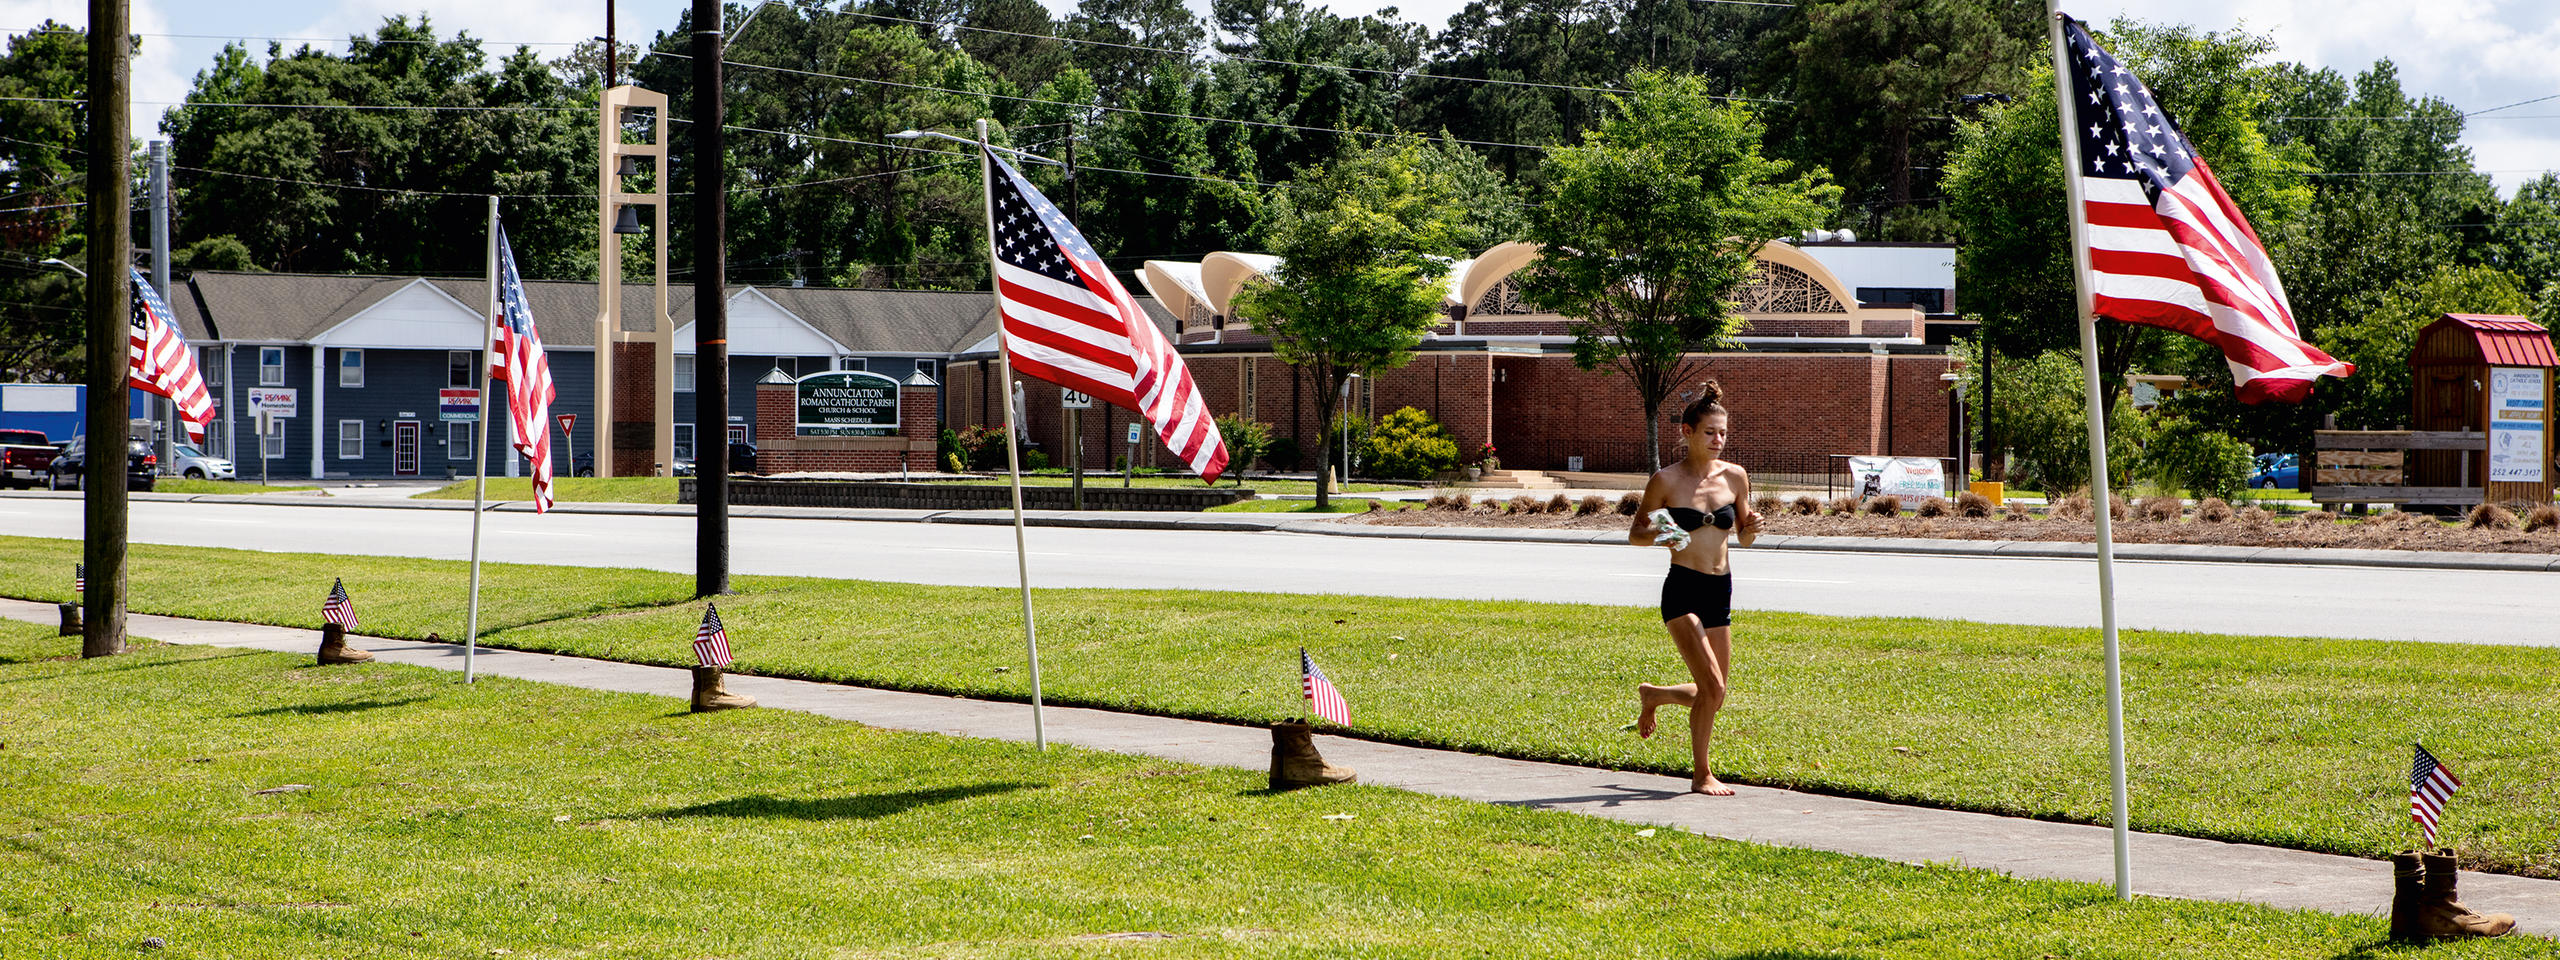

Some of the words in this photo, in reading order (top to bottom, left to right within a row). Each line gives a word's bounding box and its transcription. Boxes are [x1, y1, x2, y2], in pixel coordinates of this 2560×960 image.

[812, 388, 884, 398] ANNUNCIATION
[1064, 390, 1089, 404] 40
[265, 394, 291, 402] RE/MAX
[801, 398, 829, 406] ROMAN
[830, 398, 868, 407] CATHOLIC
[869, 399, 894, 407] PARISH
